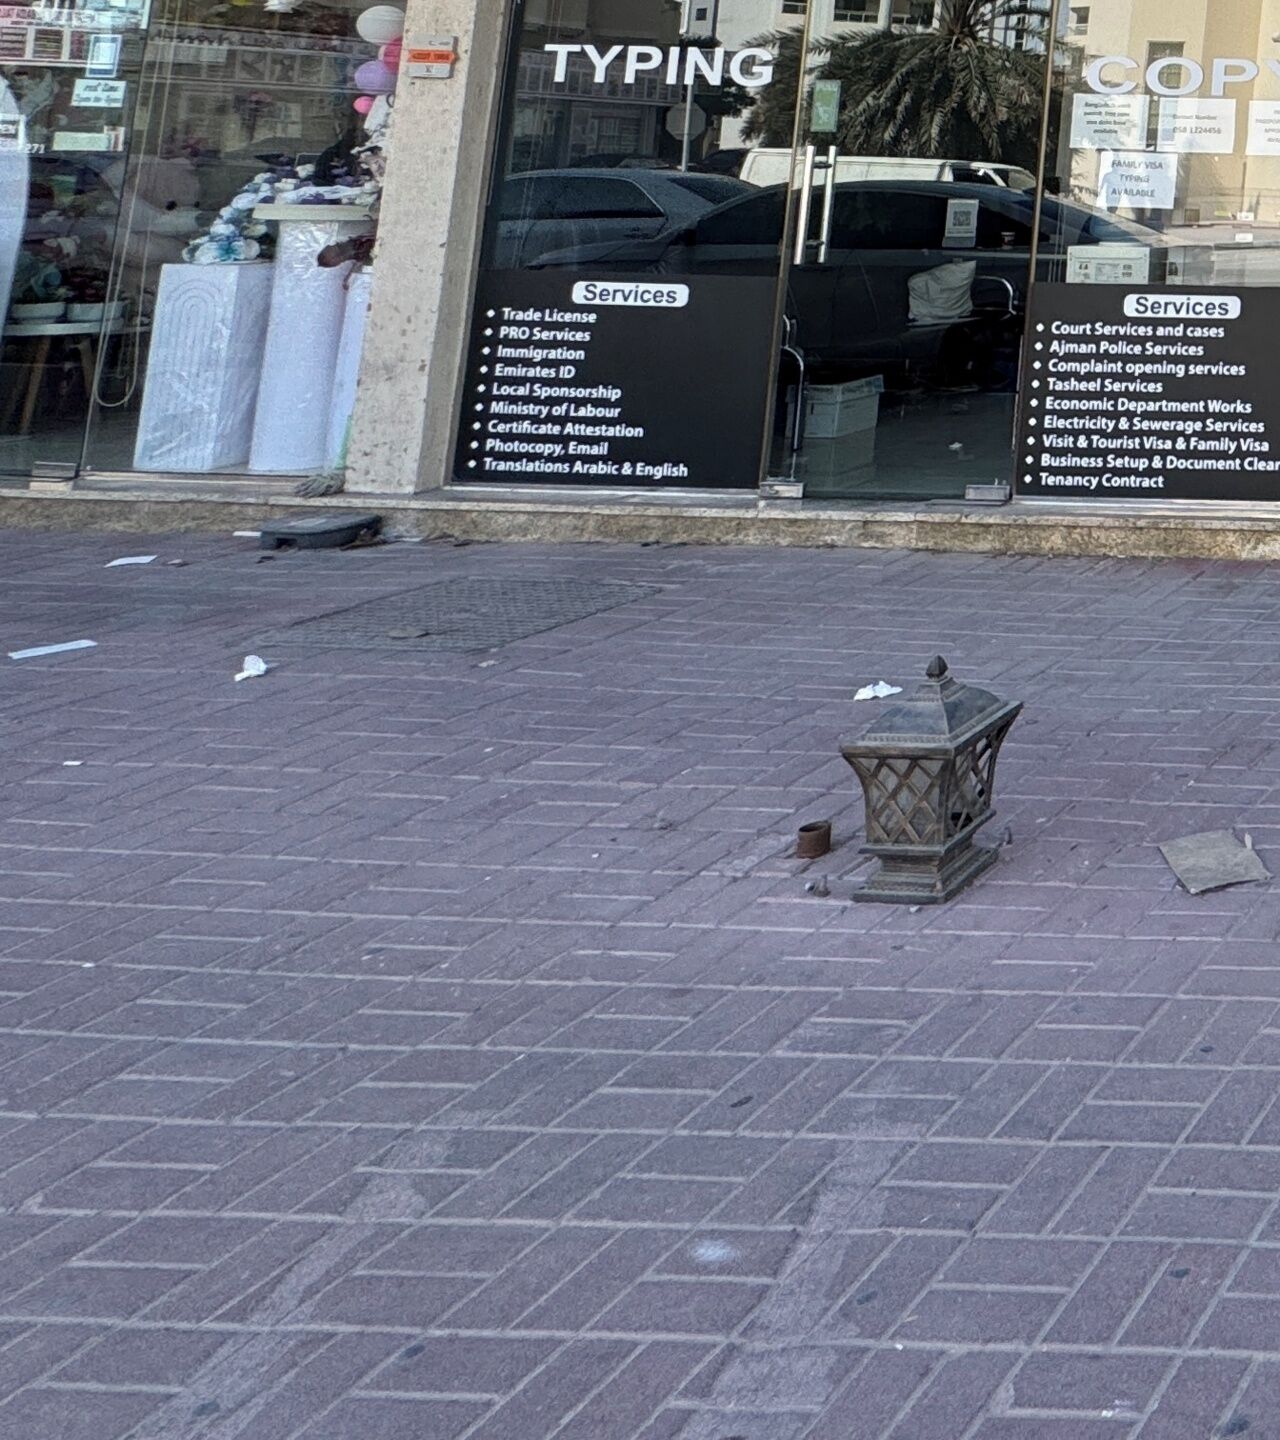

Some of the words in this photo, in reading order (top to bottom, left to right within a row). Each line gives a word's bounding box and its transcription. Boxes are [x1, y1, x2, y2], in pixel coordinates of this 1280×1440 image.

[544, 44, 774, 87] TYPING
[1145, 160, 1164, 170] VISA
[583, 283, 678, 304] Services
[502, 307, 542, 322] Trade
[544, 308, 597, 323] License
[1134, 295, 1230, 317] Services
[499, 326, 530, 340] PRO
[532, 327, 591, 341] Services
[1051, 320, 1091, 335] Court
[1094, 322, 1153, 337] Services
[1156, 323, 1184, 338] and
[1186, 326, 1225, 338] cases
[497, 345, 585, 362] Immigration
[1049, 340, 1097, 357] Ajman
[1099, 341, 1142, 355] Police
[1145, 342, 1205, 357] Services
[494, 363, 556, 378] Emirates
[558, 365, 576, 379] ID
[1047, 358, 1123, 376] Complaint
[1125, 361, 1186, 378] opening
[1188, 363, 1246, 376] services
[492, 382, 530, 396] Local
[532, 383, 622, 402] Sponsorship
[1047, 376, 1102, 392] Tasheel
[1103, 378, 1164, 393] Services
[490, 401, 548, 419] Ministry
[551, 402, 567, 416] of
[569, 403, 621, 418] Labour
[1045, 396, 1115, 411] Economic
[1117, 397, 1205, 414] Department
[1207, 399, 1253, 414] Works
[487, 419, 561, 435] Certificate
[563, 421, 644, 437] Attestation
[1043, 414, 1115, 432] Electricity
[1117, 416, 1130, 430] &
[1132, 417, 1204, 434] Sewerage
[1206, 418, 1266, 433] Services
[485, 438, 565, 457] Photocopy,
[568, 441, 609, 455] Email
[1042, 434, 1074, 449] Visit
[1076, 435, 1089, 449] &
[1091, 435, 1141, 450] Tourist
[1143, 436, 1173, 451] Visa
[1175, 437, 1188, 451] &
[1189, 437, 1238, 455] Family
[1240, 438, 1270, 453] Visa
[483, 456, 570, 474] Translations
[572, 459, 619, 475] Arabic
[621, 461, 634, 475] &
[635, 462, 688, 480] English
[1040, 453, 1104, 469] Business
[1106, 455, 1149, 472] Setup
[1151, 456, 1164, 470] &
[1166, 456, 1242, 471] Document
[1039, 471, 1099, 491] Tenancy
[1102, 473, 1165, 489] Contract
